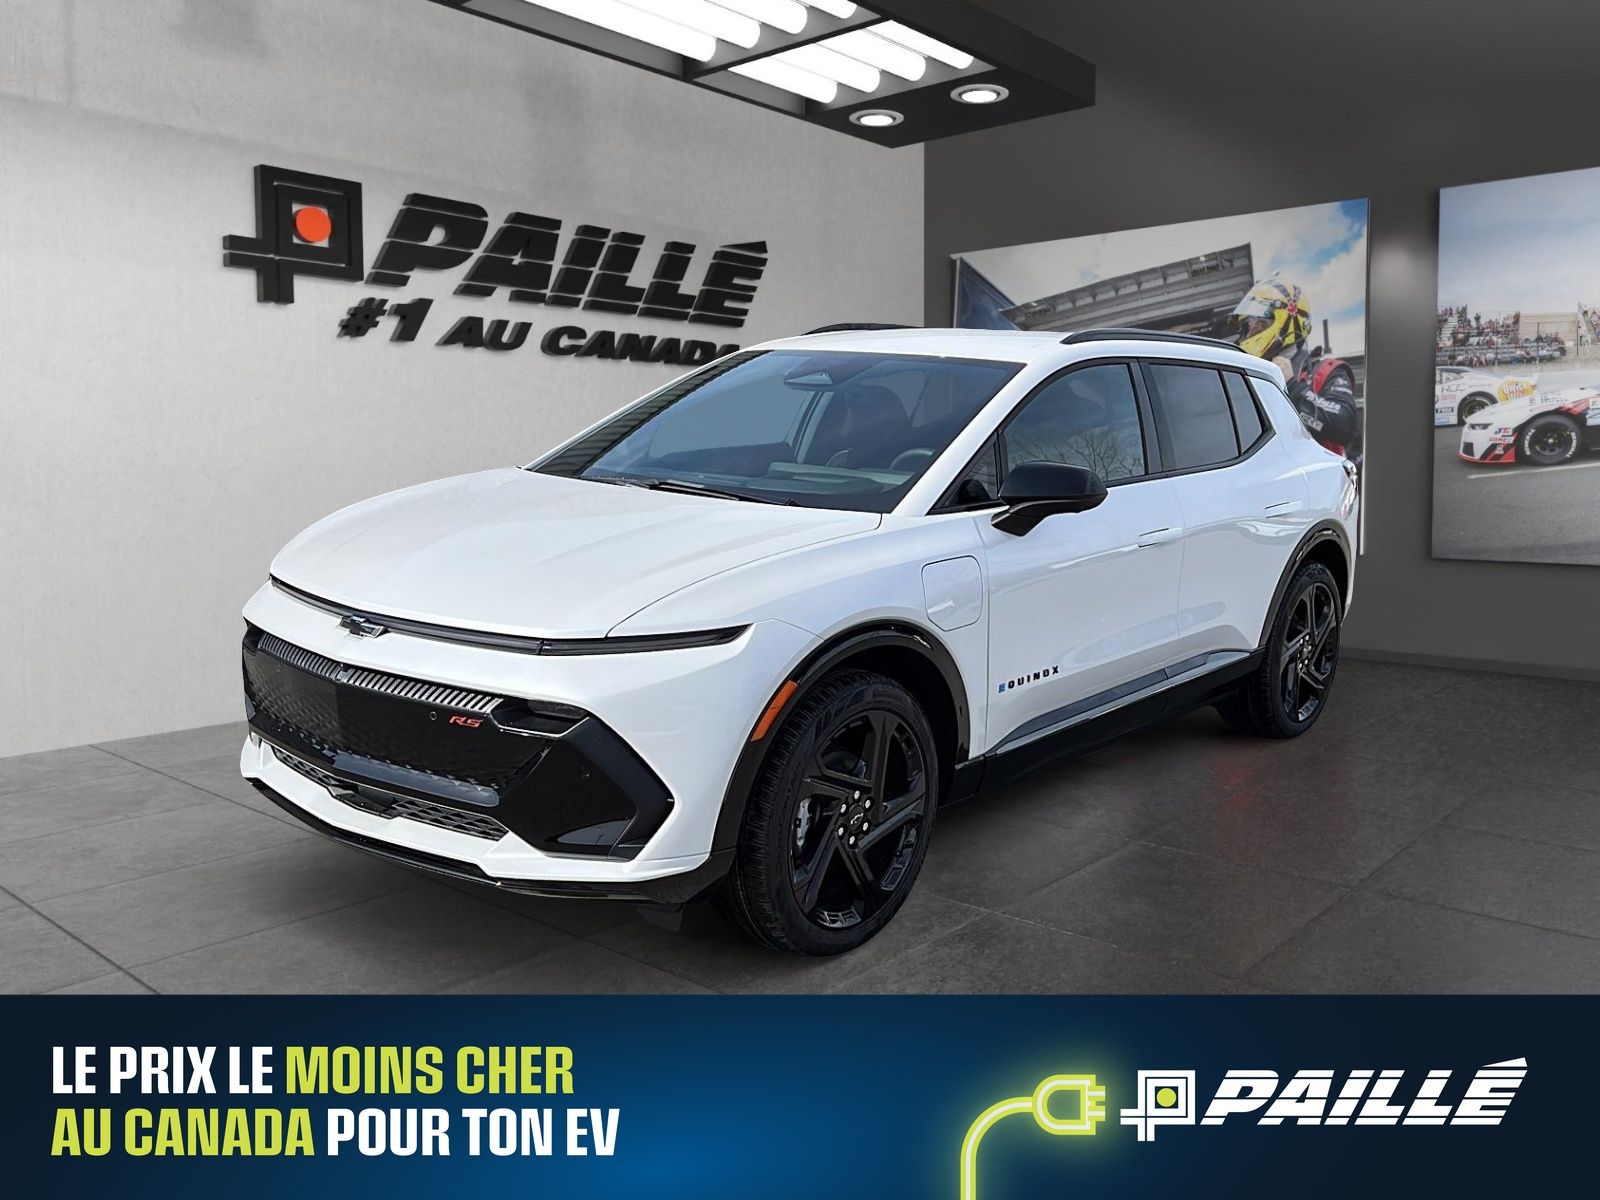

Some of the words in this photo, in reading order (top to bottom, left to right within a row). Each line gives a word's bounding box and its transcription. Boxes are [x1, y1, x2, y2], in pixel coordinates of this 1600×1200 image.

[365, 193, 769, 328] PAILLÉ
[338, 297, 434, 342] #1
[436, 316, 533, 351] AU
[998, 665, 1059, 693] EQUINOX
[449, 715, 483, 728] RS
